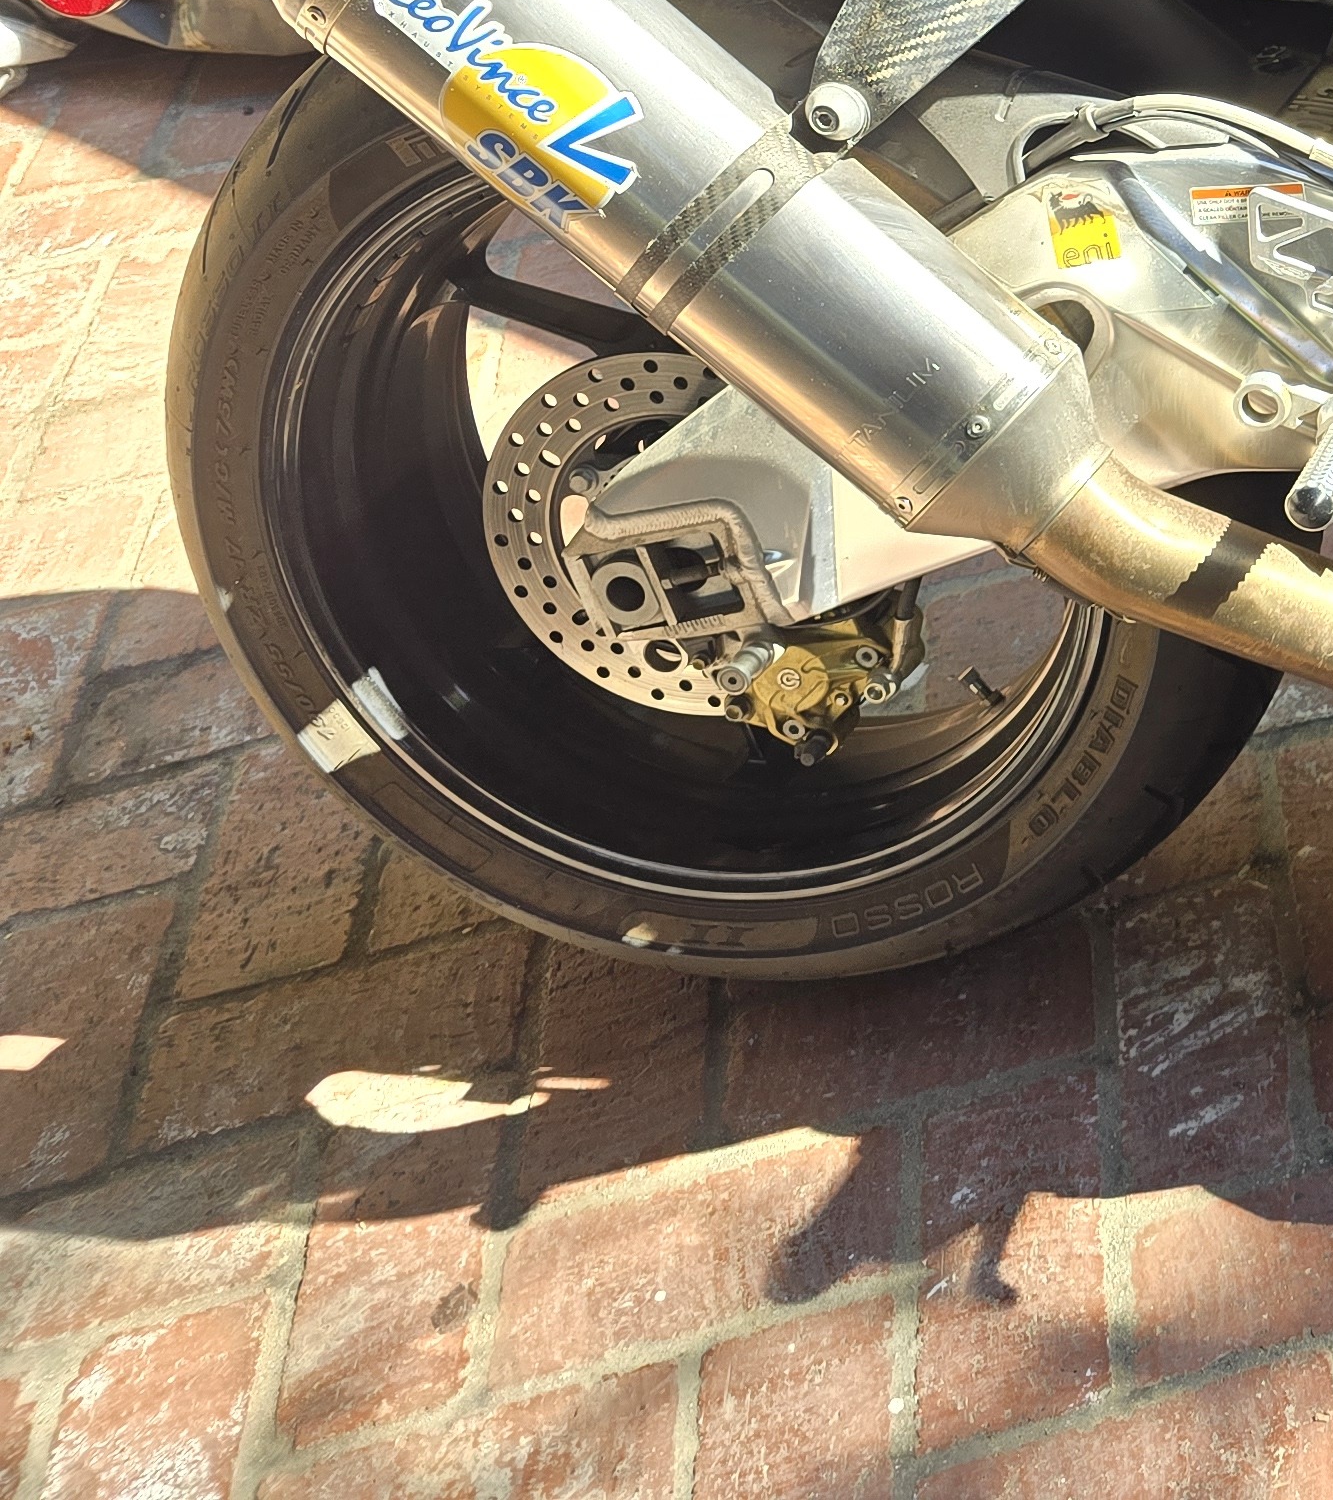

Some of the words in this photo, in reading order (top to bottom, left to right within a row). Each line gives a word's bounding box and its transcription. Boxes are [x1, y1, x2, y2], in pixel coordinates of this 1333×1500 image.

[462, 72, 539, 142] SYSTEMS
[465, 131, 590, 230] SBK
[1062, 233, 1115, 268] eni
[1028, 673, 1139, 838] DIABLO
[831, 861, 985, 940] ROSSO
